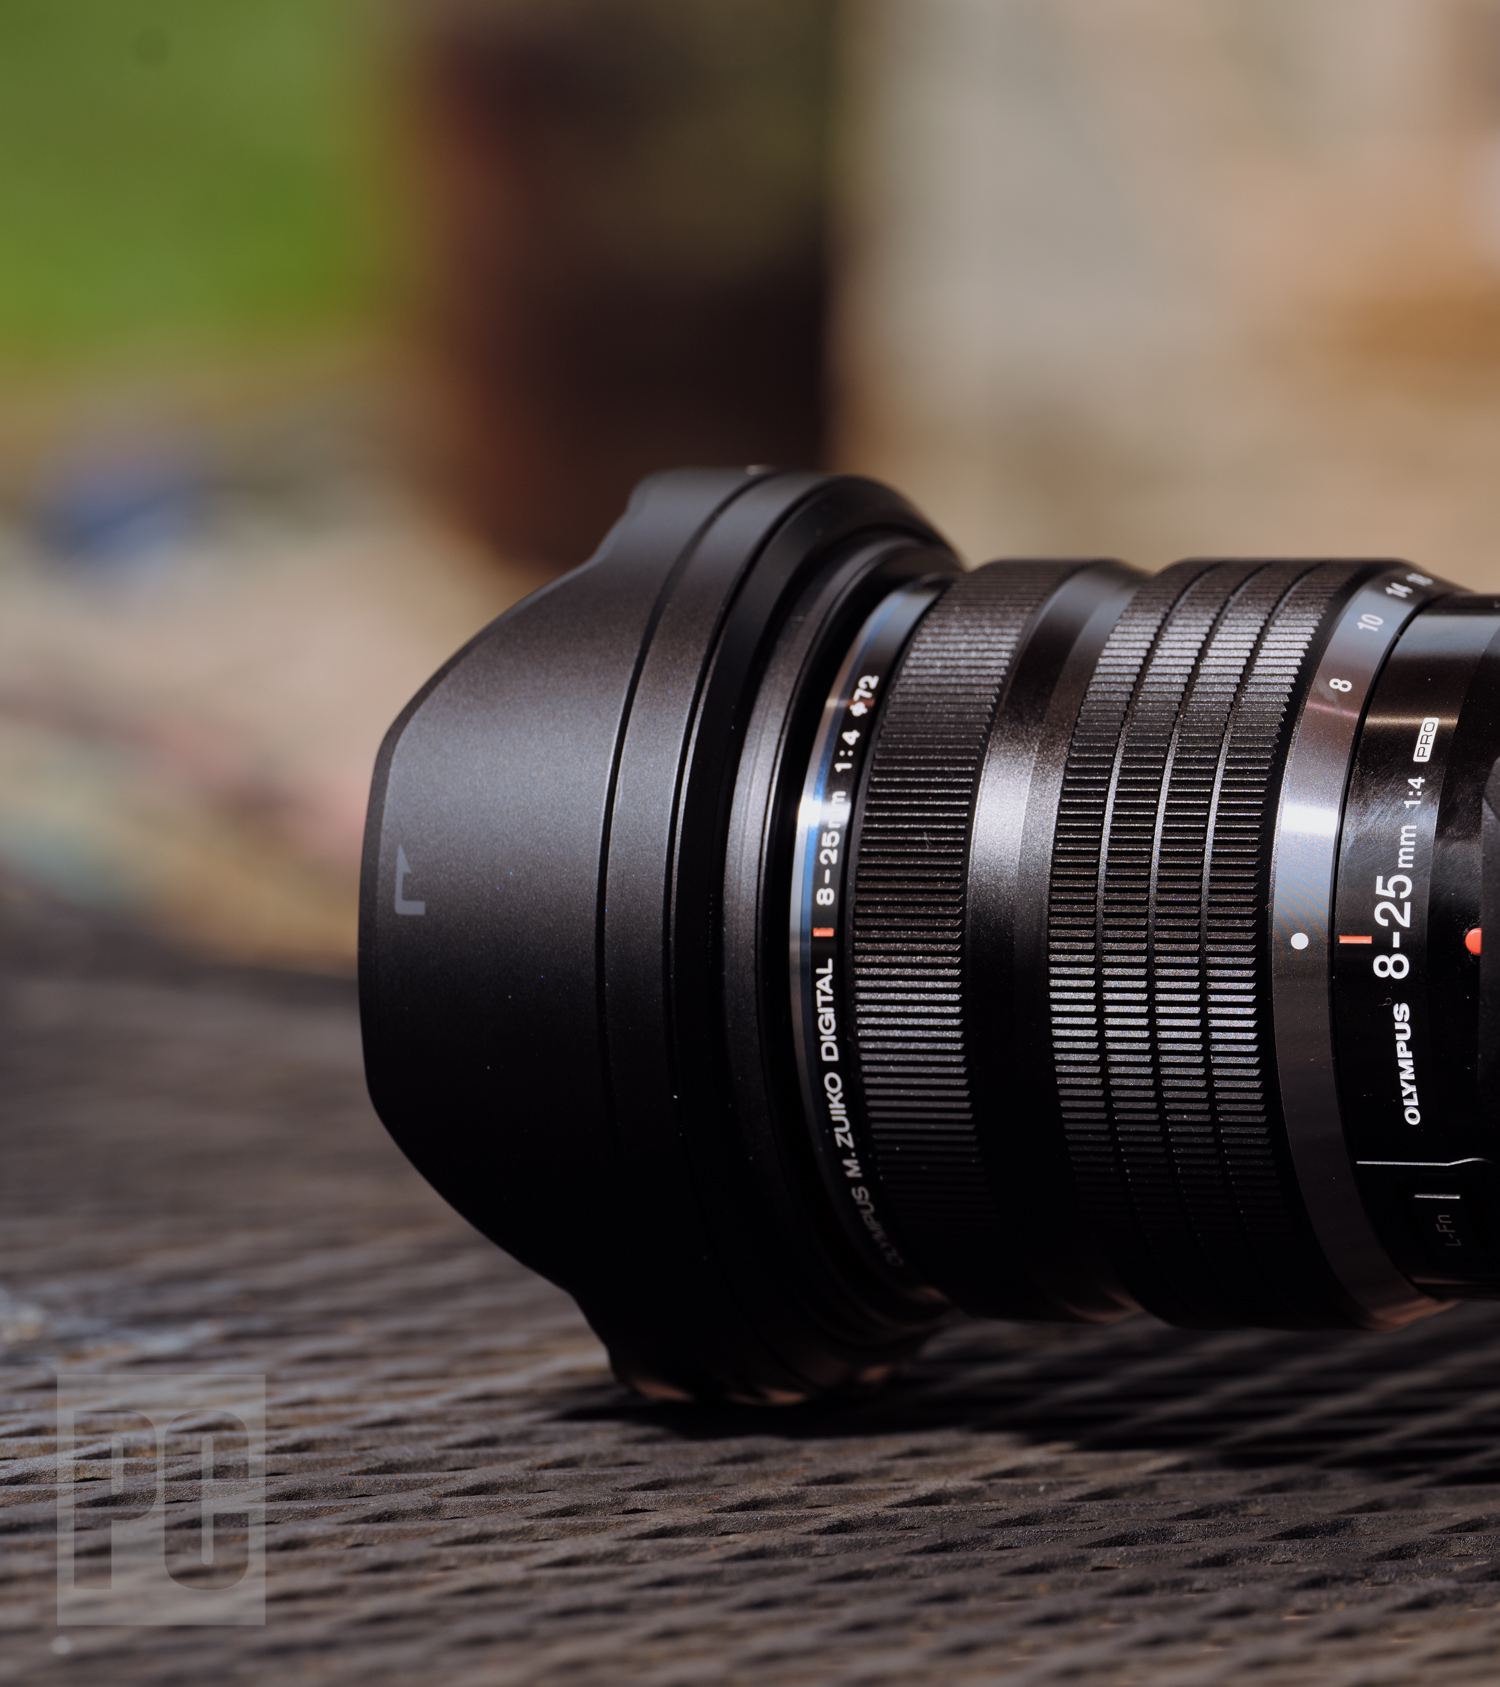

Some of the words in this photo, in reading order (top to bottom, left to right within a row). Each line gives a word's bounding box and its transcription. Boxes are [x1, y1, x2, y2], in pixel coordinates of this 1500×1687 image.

[1356, 613, 1385, 632] 10
[1328, 677, 1353, 693] 8
[1415, 720, 1437, 759] PRO
[1403, 776, 1426, 809] 1:4
[814, 957, 840, 1062] DIGITAL
[834, 729, 861, 773] 1:4
[1392, 1001, 1422, 1127] OLYMPUS
[1435, 1214, 1462, 1247] L-Fn
